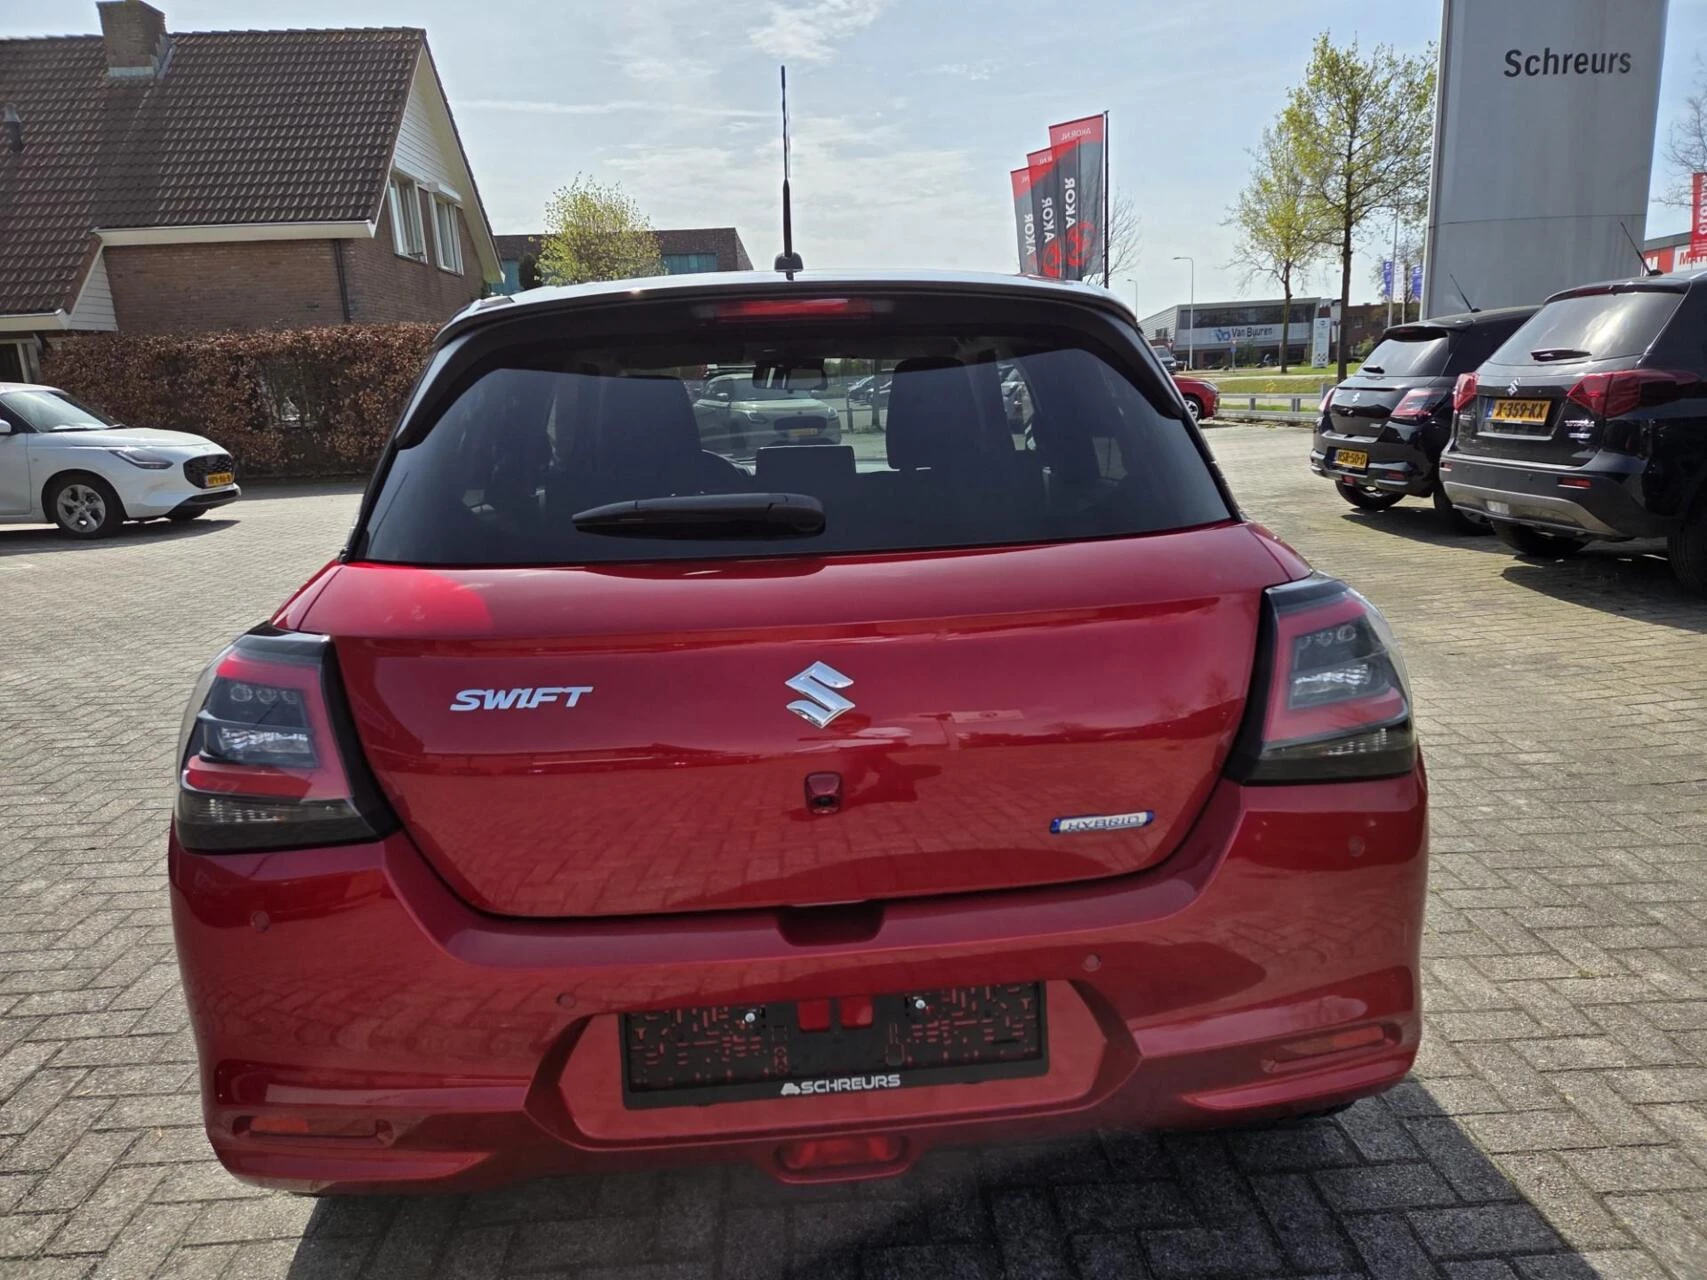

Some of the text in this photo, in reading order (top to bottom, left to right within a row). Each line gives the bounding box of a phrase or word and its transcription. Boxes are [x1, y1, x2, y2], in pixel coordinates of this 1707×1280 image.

[1503, 47, 1632, 78] Schreurs
[1231, 327, 1246, 338] Van
[449, 686, 594, 712] SWIFT
[1067, 814, 1142, 832] HYBRID
[800, 1074, 901, 1095] SCHREURS
